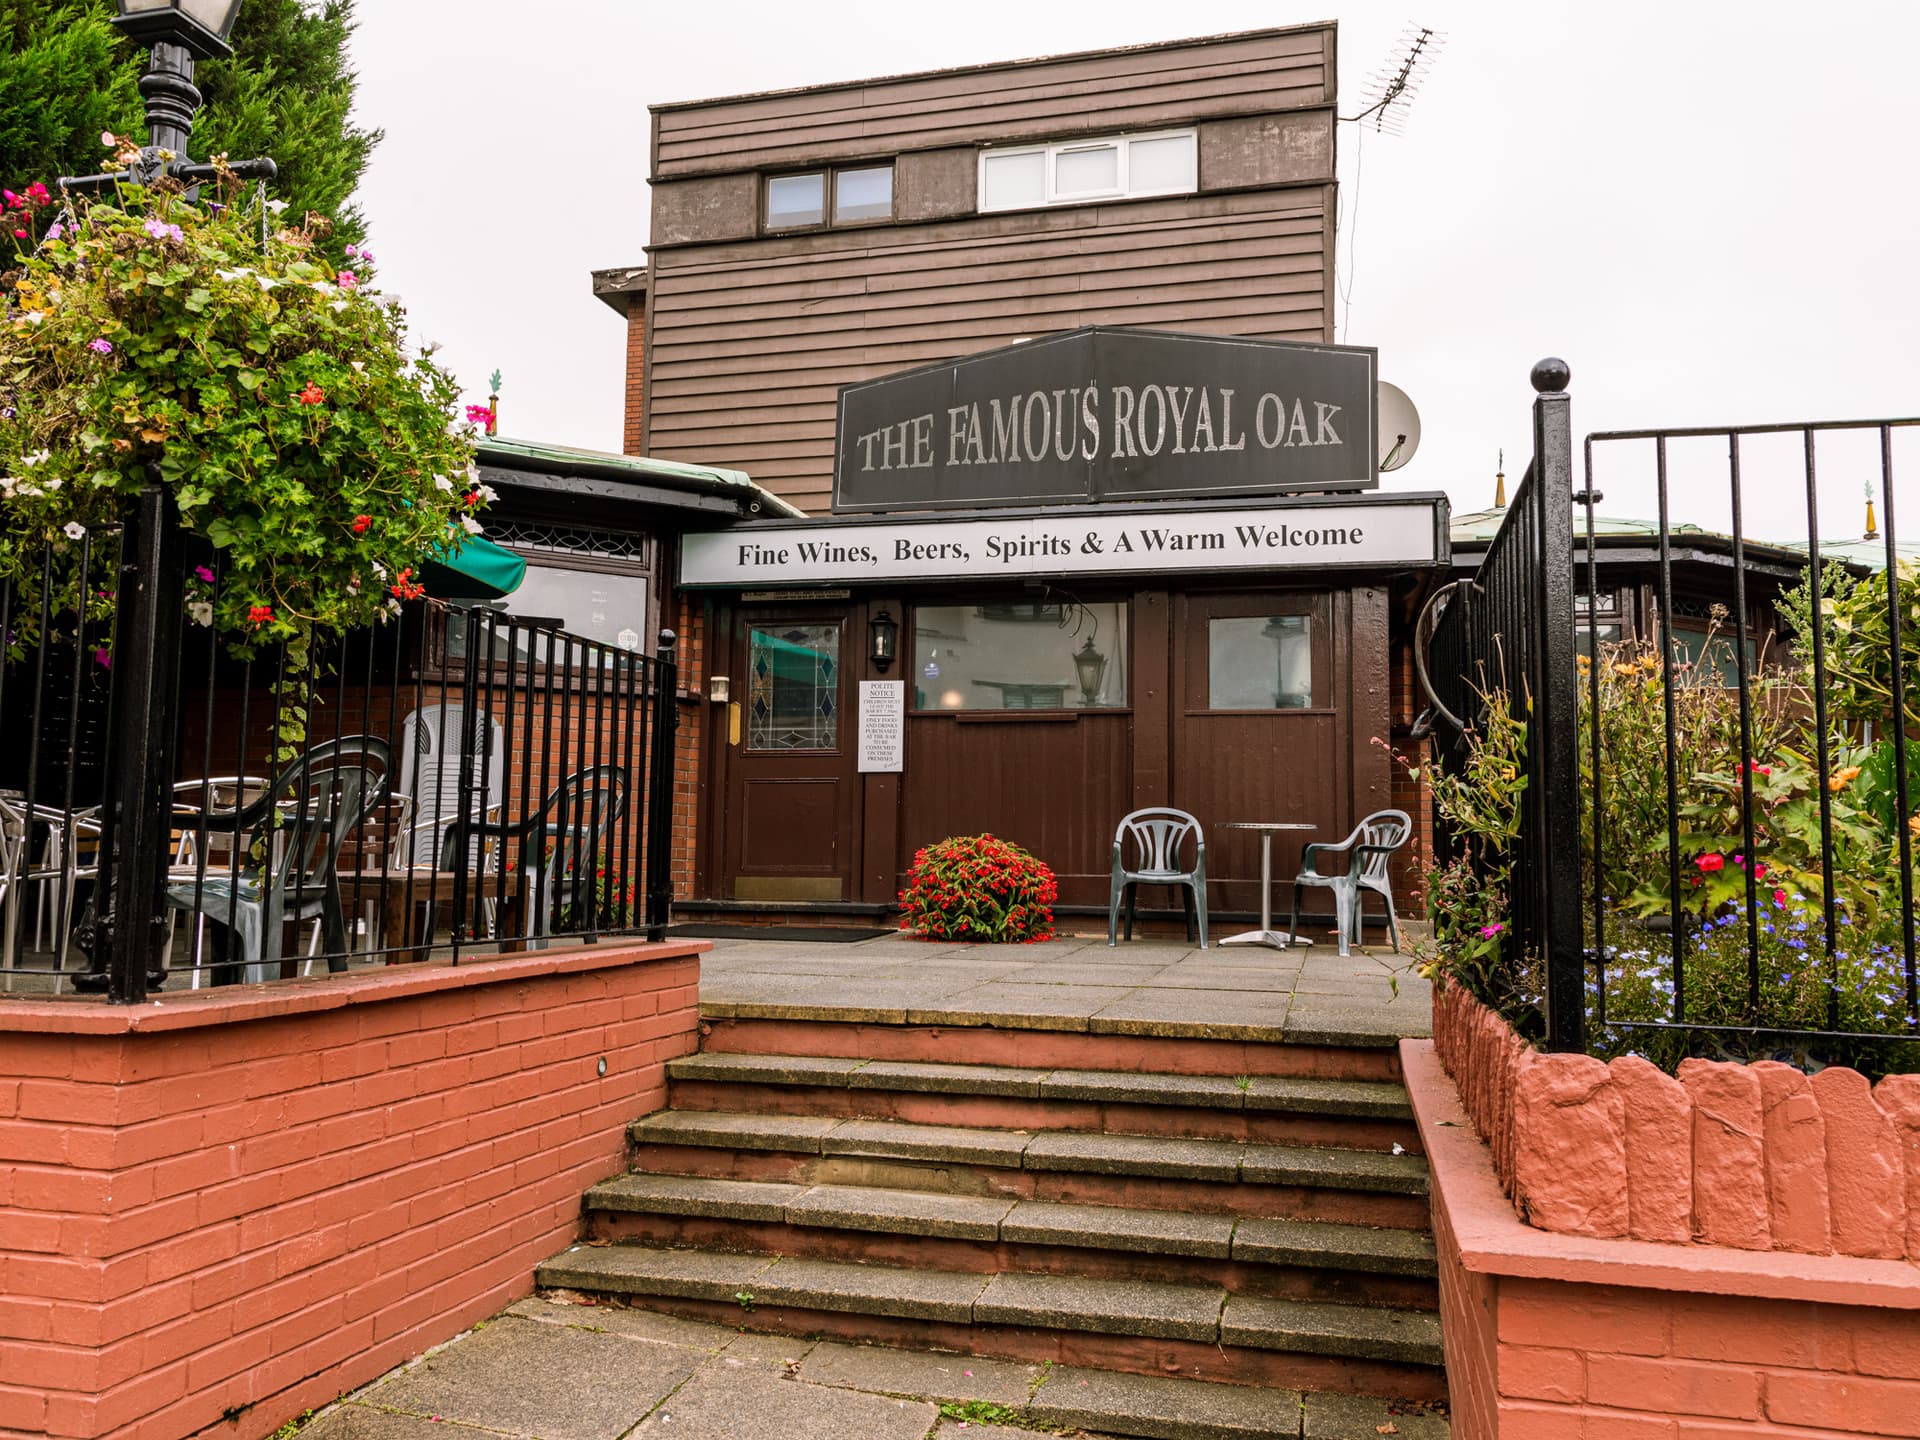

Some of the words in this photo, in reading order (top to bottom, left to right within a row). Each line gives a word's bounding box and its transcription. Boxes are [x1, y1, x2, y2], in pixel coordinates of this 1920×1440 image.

[857, 413, 934, 472] THE
[946, 386, 1100, 465] FAMOUS
[1111, 384, 1246, 458] ROYAL
[1255, 392, 1343, 448] OAK
[737, 545, 789, 566] Fine
[797, 541, 878, 566] Wines,
[894, 538, 971, 563] Beers,
[985, 532, 1071, 564] Spirits
[1080, 532, 1105, 555] &
[1113, 530, 1135, 553] A
[1139, 528, 1225, 551] Warm
[1234, 524, 1364, 549] Welcome
